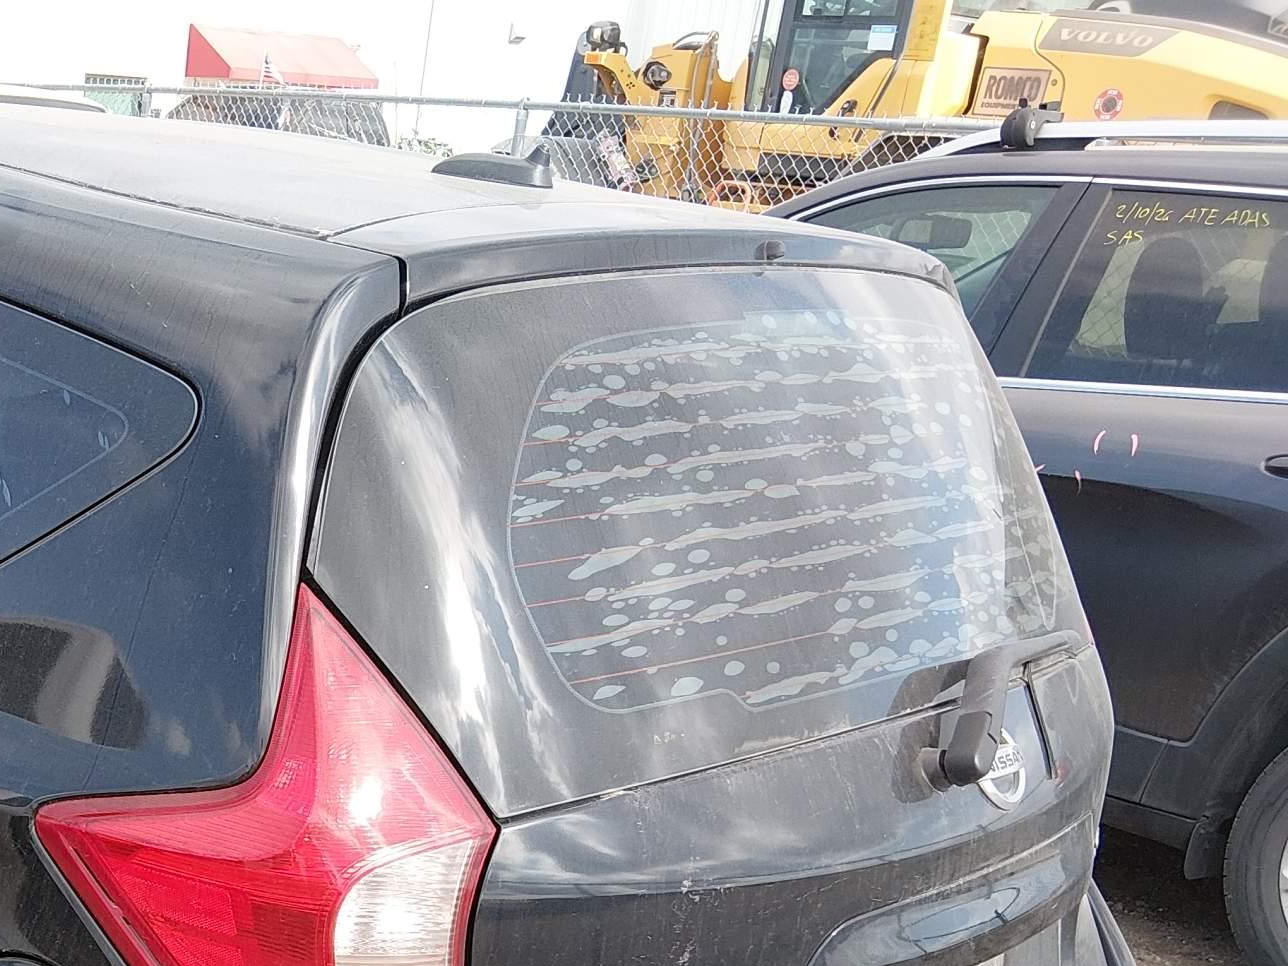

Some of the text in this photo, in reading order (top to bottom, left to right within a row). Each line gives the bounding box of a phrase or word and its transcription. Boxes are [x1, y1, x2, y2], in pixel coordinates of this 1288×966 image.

[1059, 27, 1154, 48] VOLVO
[1178, 207, 1220, 226] ATE
[1220, 209, 1271, 229] ADAS
[1103, 229, 1145, 246] SAS
